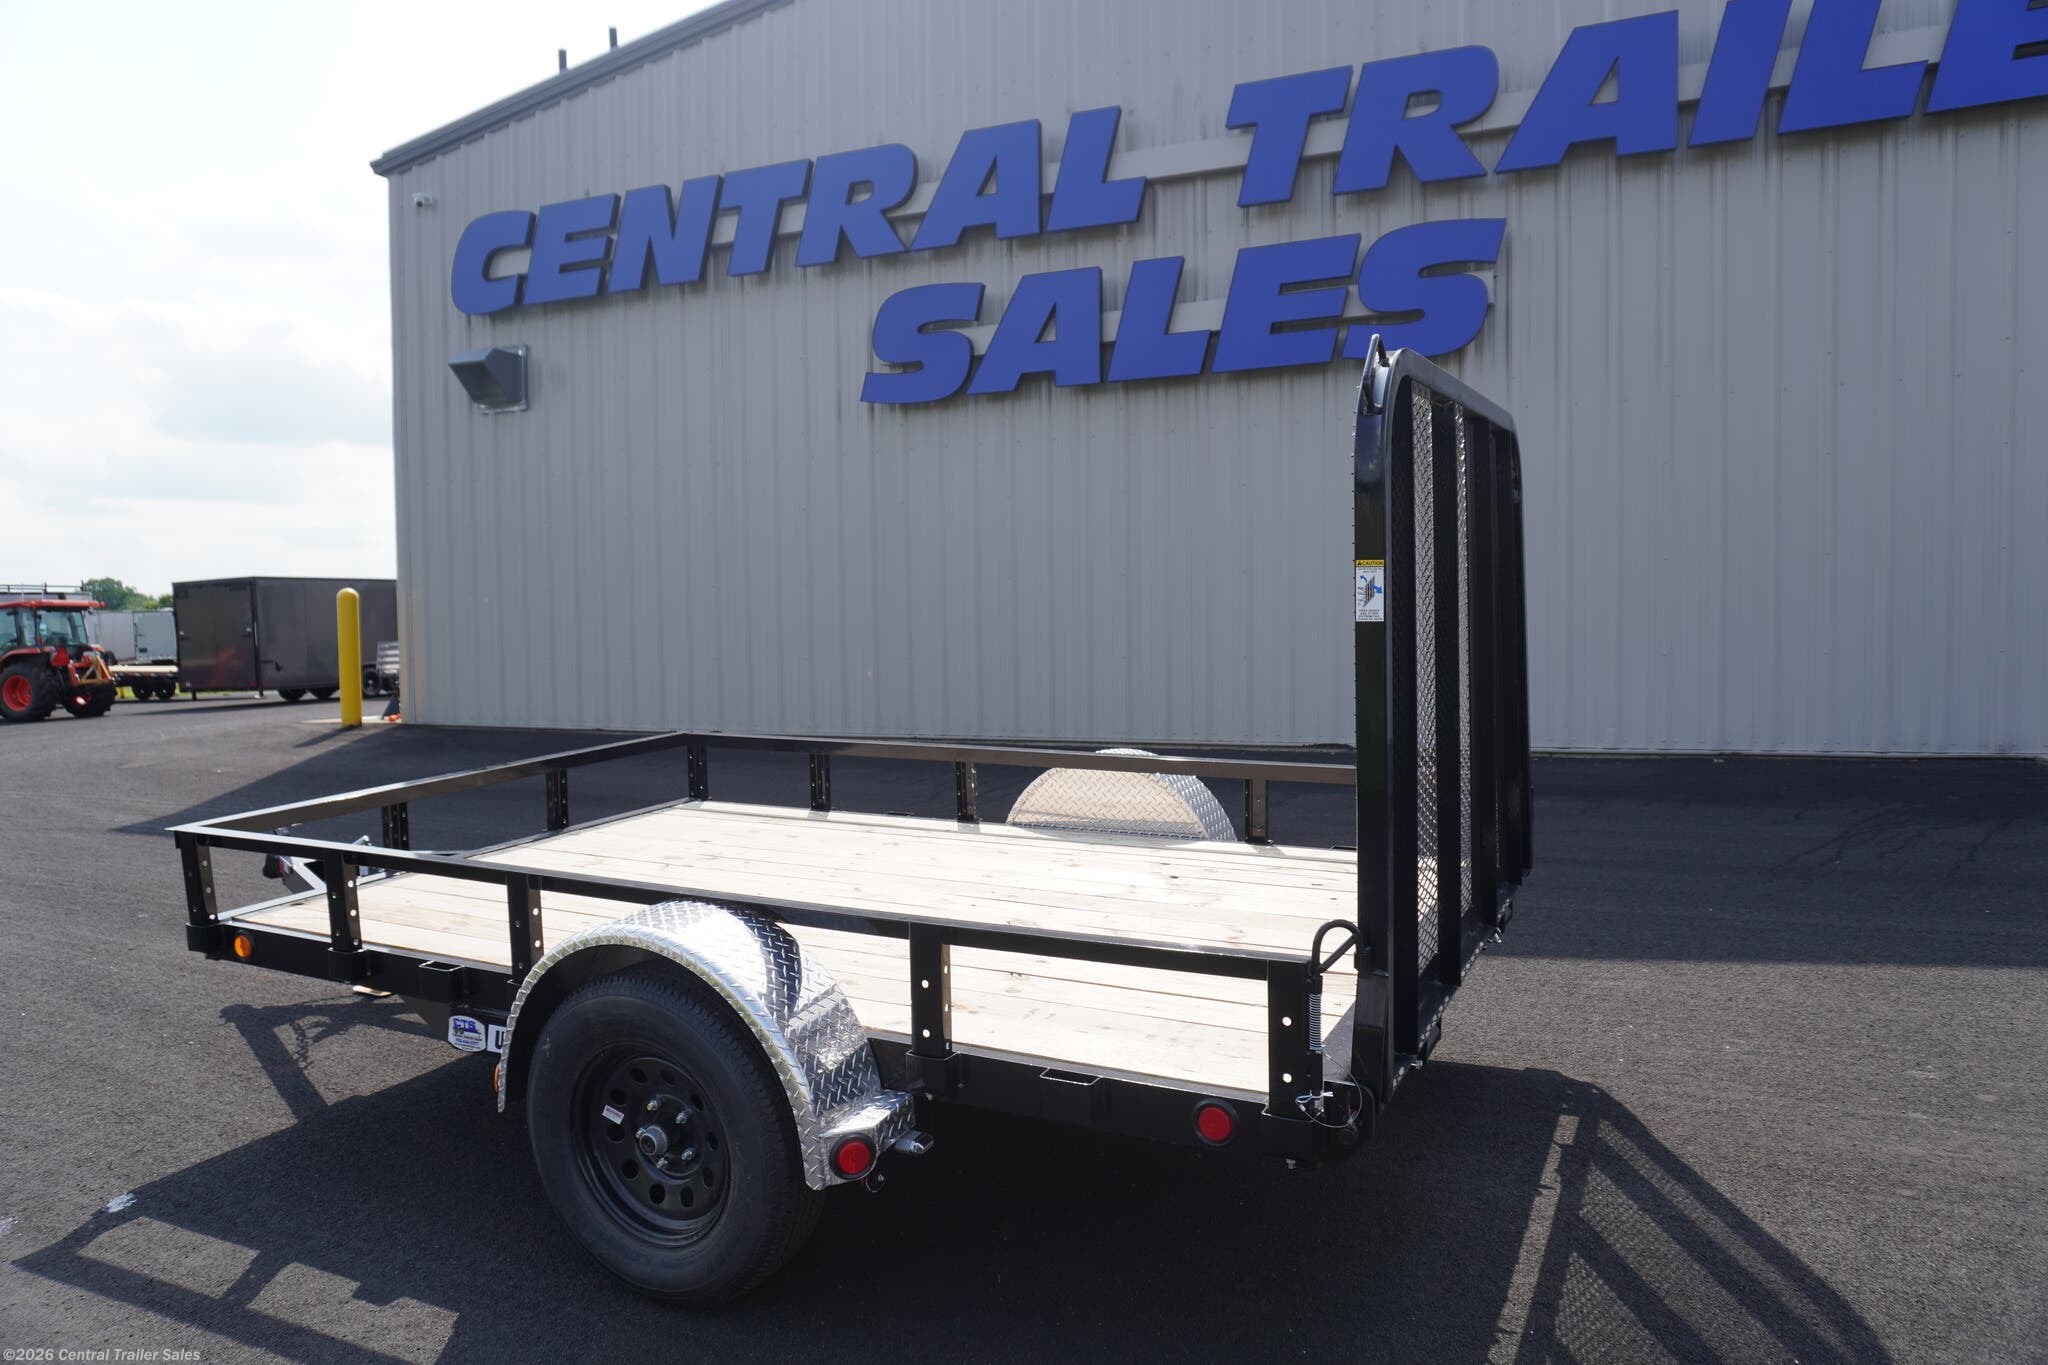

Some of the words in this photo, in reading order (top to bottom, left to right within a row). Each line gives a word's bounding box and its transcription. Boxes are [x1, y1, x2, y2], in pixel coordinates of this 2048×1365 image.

[451, 105, 1147, 315] CENTRAL
[860, 218, 1507, 404] SALES
[453, 1018, 476, 1030] CTS
